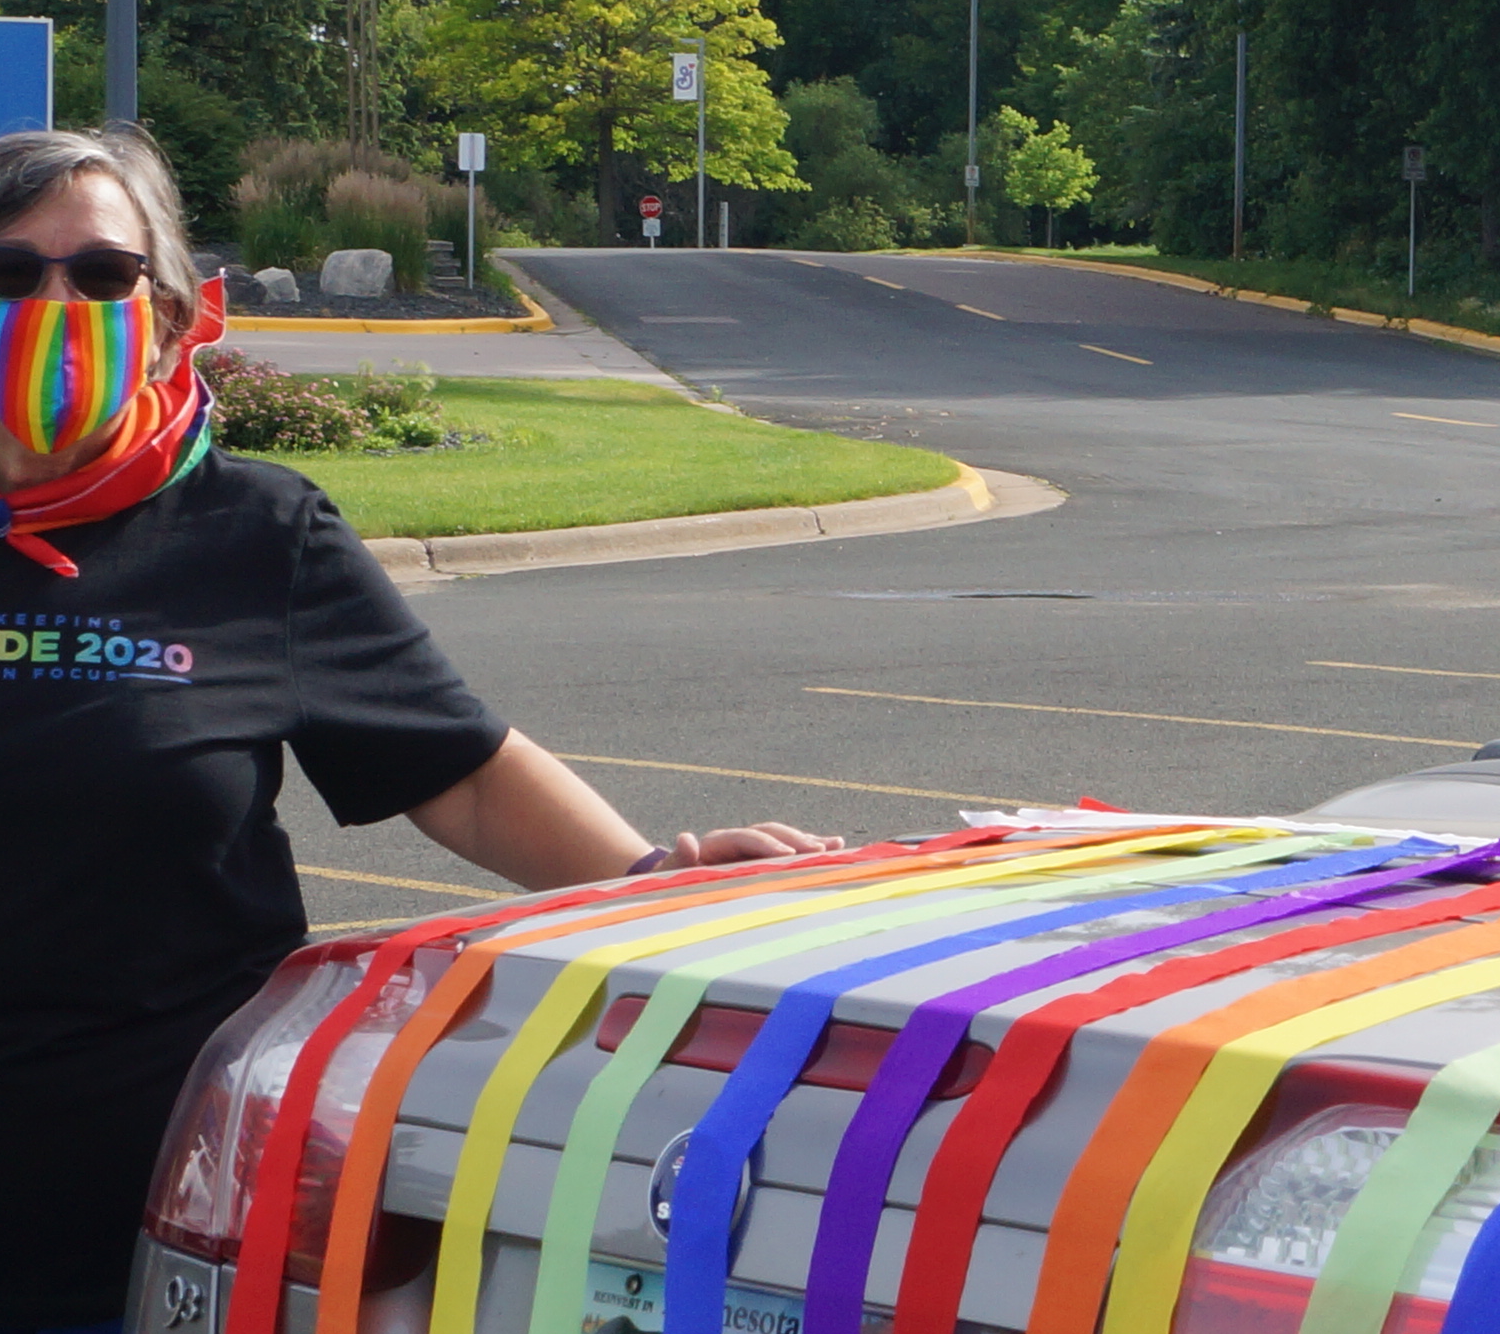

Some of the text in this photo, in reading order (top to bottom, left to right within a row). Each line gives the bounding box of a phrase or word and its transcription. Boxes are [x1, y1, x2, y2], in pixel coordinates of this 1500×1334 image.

[641, 202, 661, 213] STOP
[74, 632, 194, 674] 2020
[32, 667, 118, 682] FOCUS
